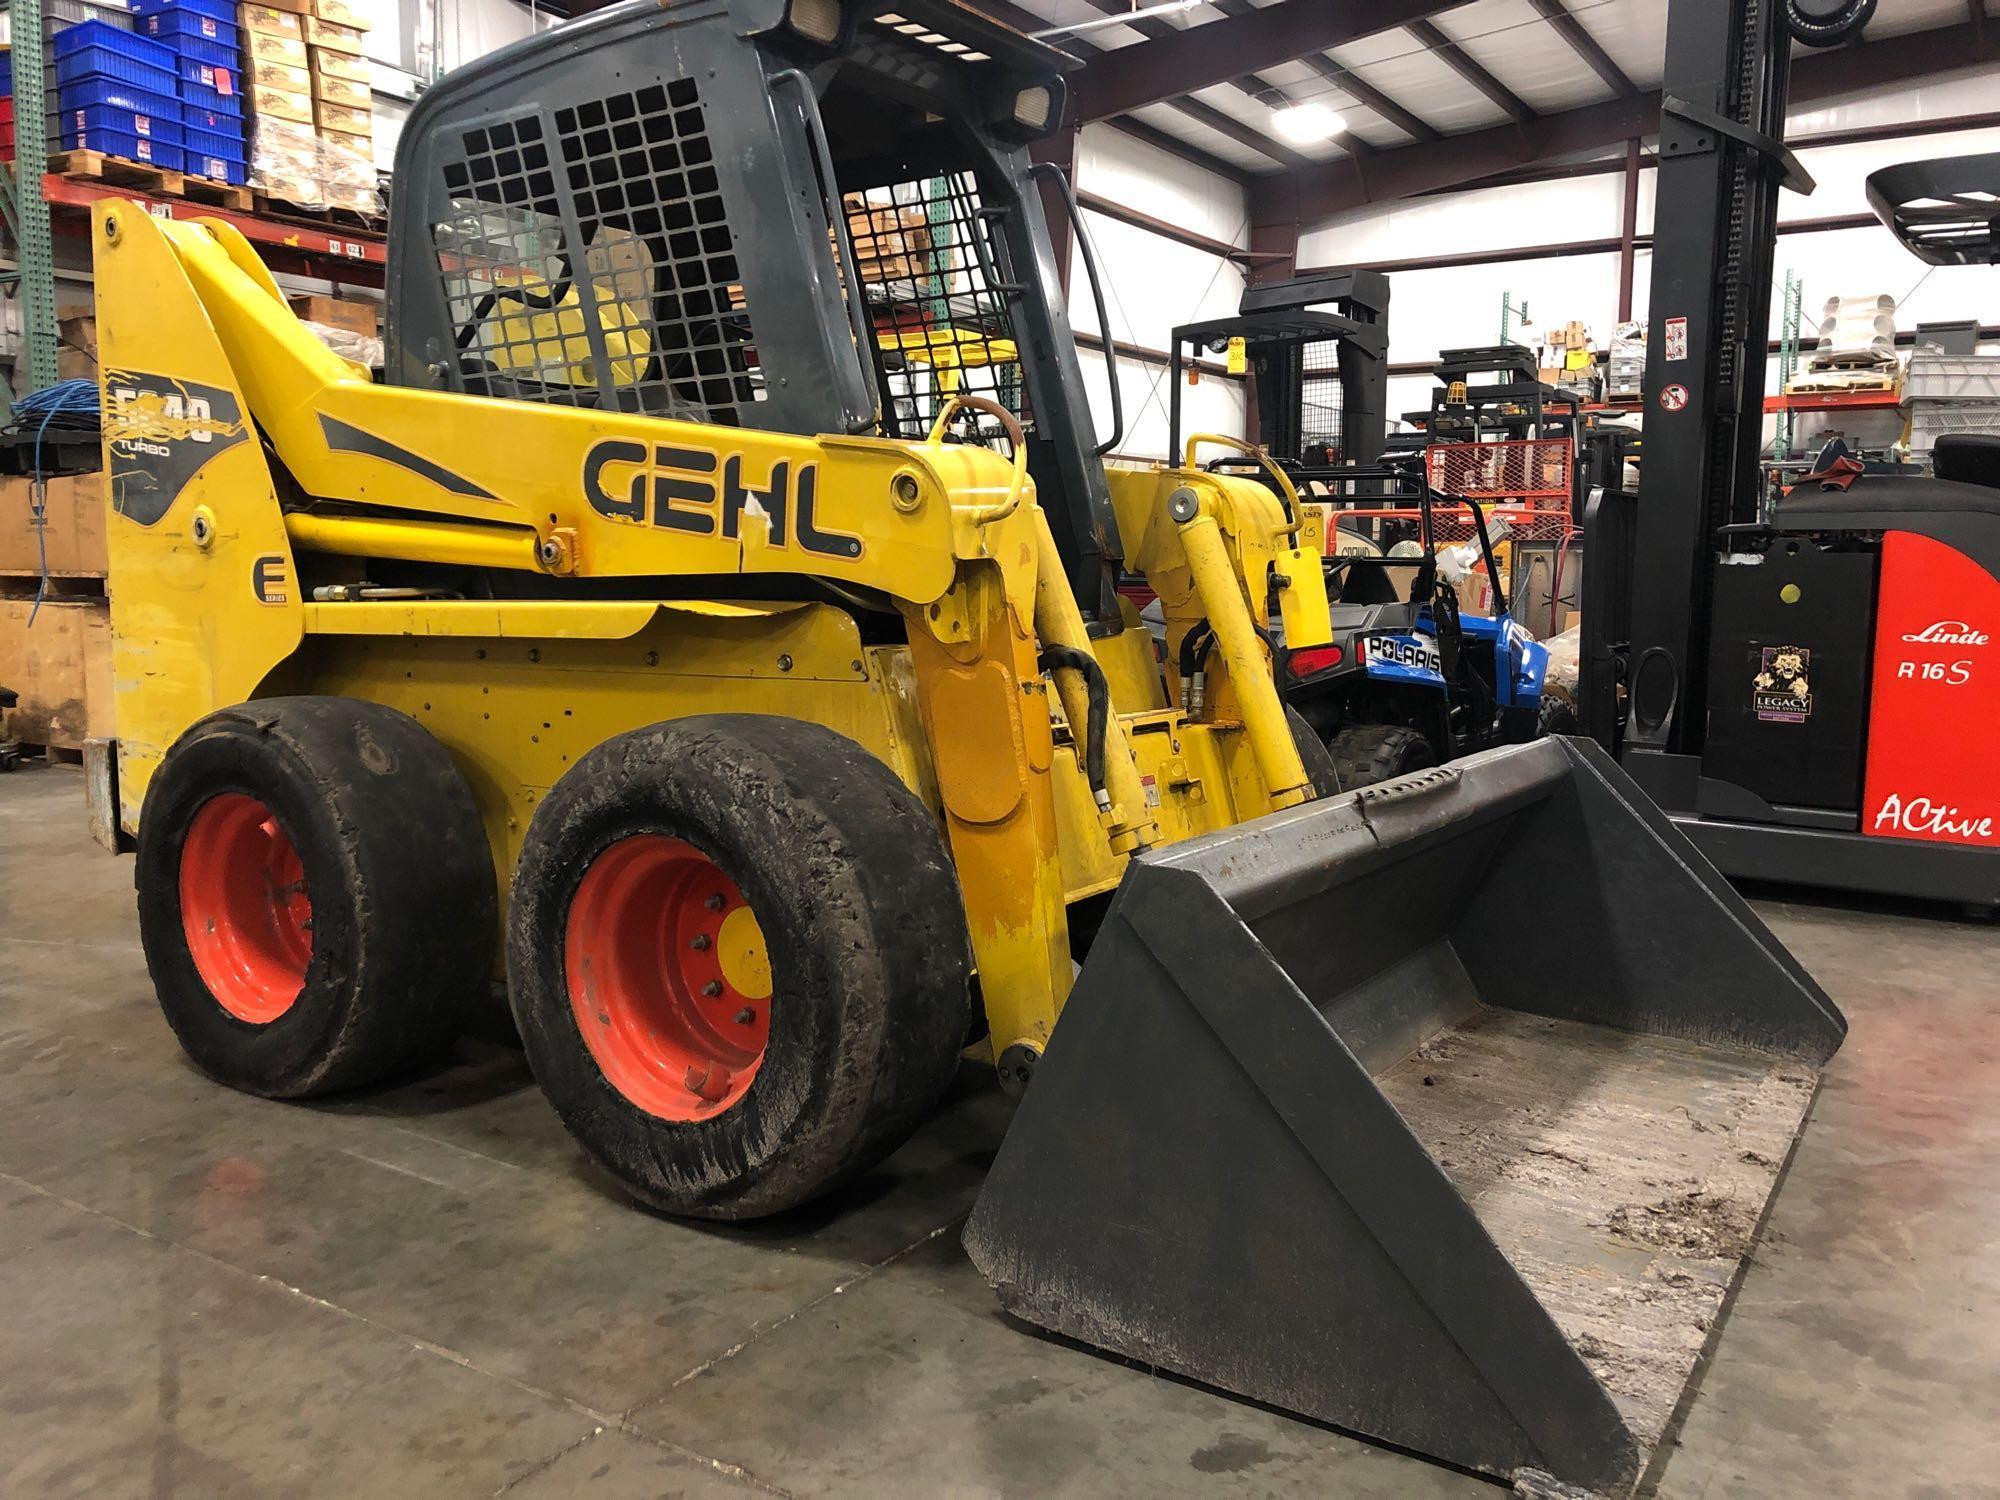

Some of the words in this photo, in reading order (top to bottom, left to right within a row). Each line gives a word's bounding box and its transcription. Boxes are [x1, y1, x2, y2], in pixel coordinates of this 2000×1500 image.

[118, 439, 170, 457] TURBO
[583, 438, 863, 560] GEHL
[1901, 620, 1990, 645] Linde
[1369, 637, 1441, 671] POLARIS
[1757, 696, 1808, 708] LEGACY
